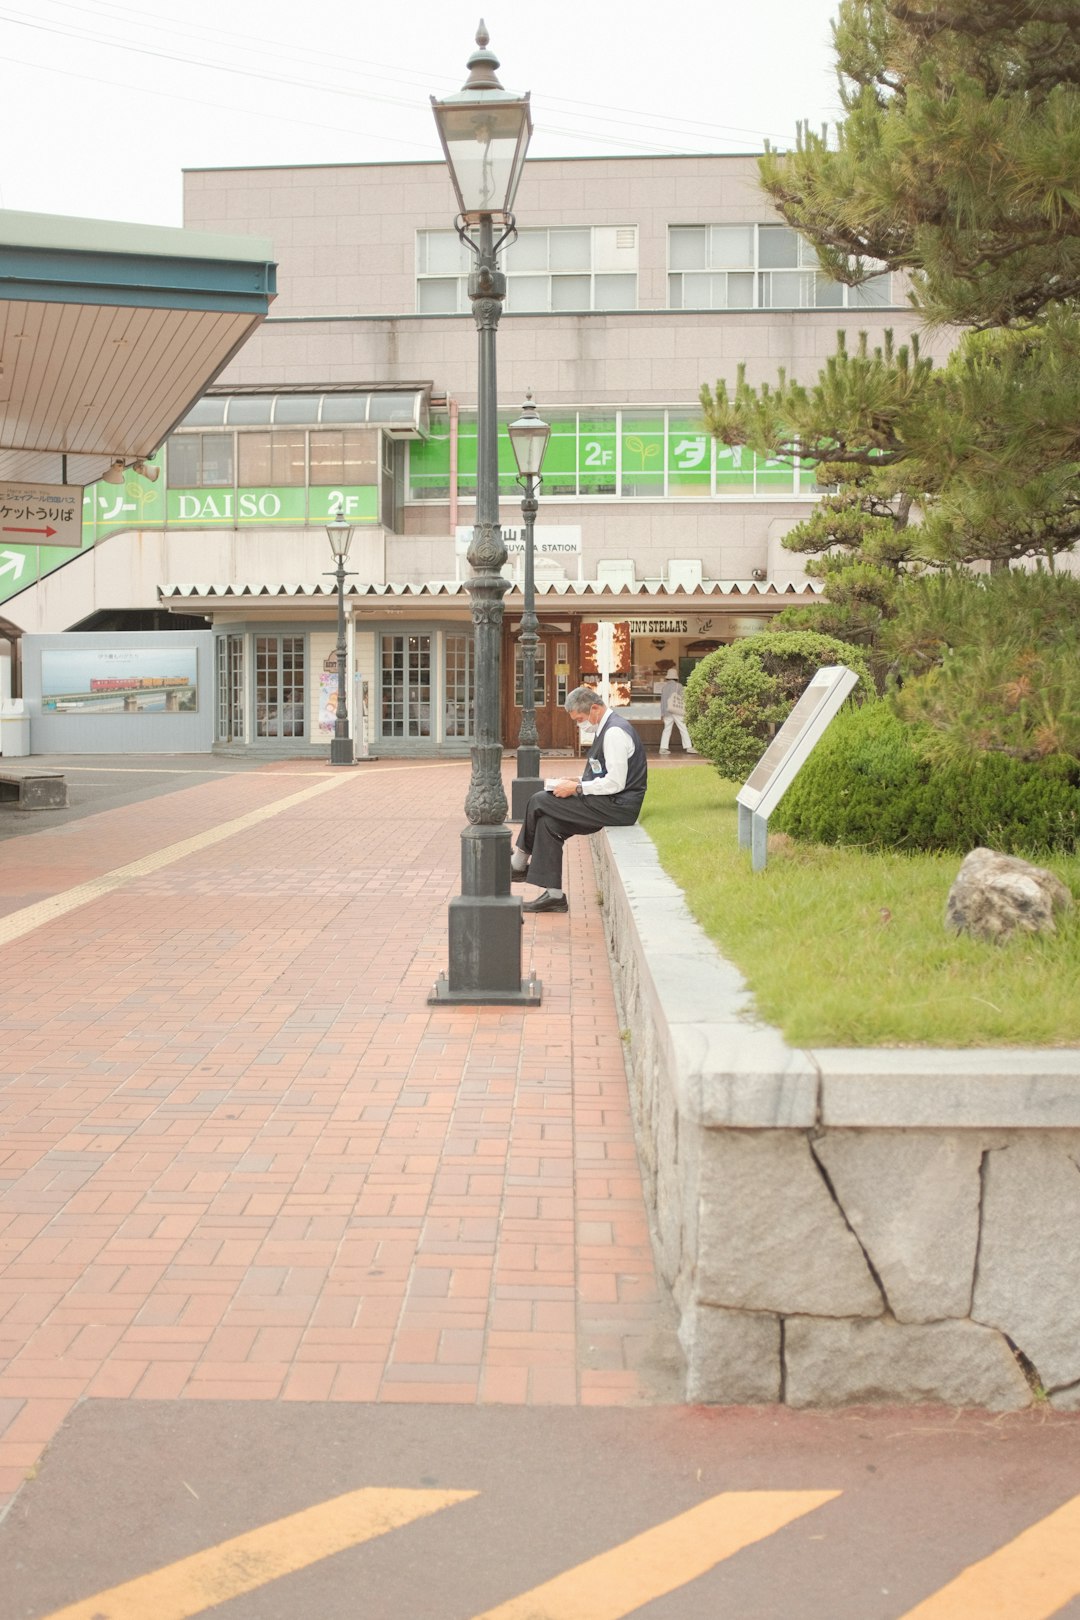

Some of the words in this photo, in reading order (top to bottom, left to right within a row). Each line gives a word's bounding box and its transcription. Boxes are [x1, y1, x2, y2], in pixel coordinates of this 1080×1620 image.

[585, 442, 612, 466] 2F
[0, 505, 75, 521] ケットうりば
[83, 496, 137, 519] ソー
[178, 493, 281, 518] DAISO
[327, 491, 359, 515] 2F
[542, 544, 577, 552] STATION
[626, 620, 647, 633] UNT
[648, 620, 688, 633] STELLA'S
